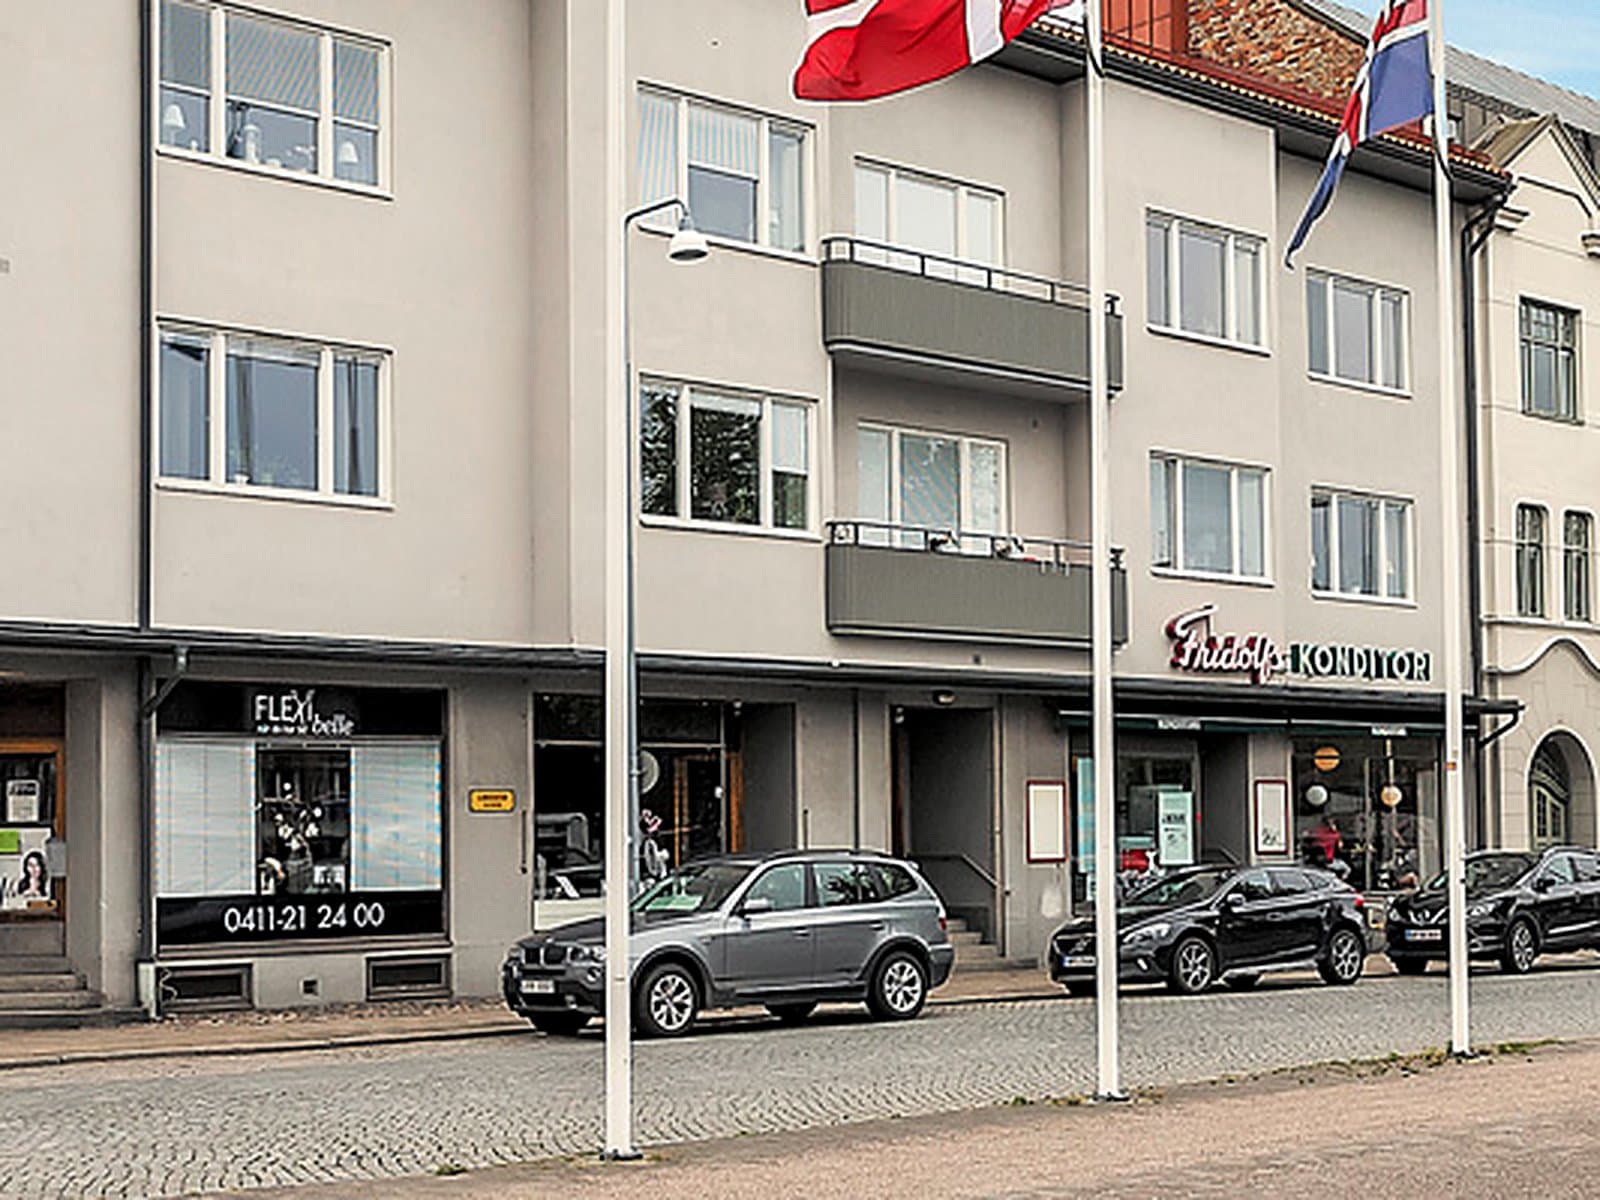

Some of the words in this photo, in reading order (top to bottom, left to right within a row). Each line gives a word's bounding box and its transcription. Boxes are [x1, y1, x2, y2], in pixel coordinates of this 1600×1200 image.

[255, 689, 315, 723] FLEXI
[223, 904, 306, 933] 0411-21
[317, 903, 347, 928] 24
[353, 902, 385, 928] 00
